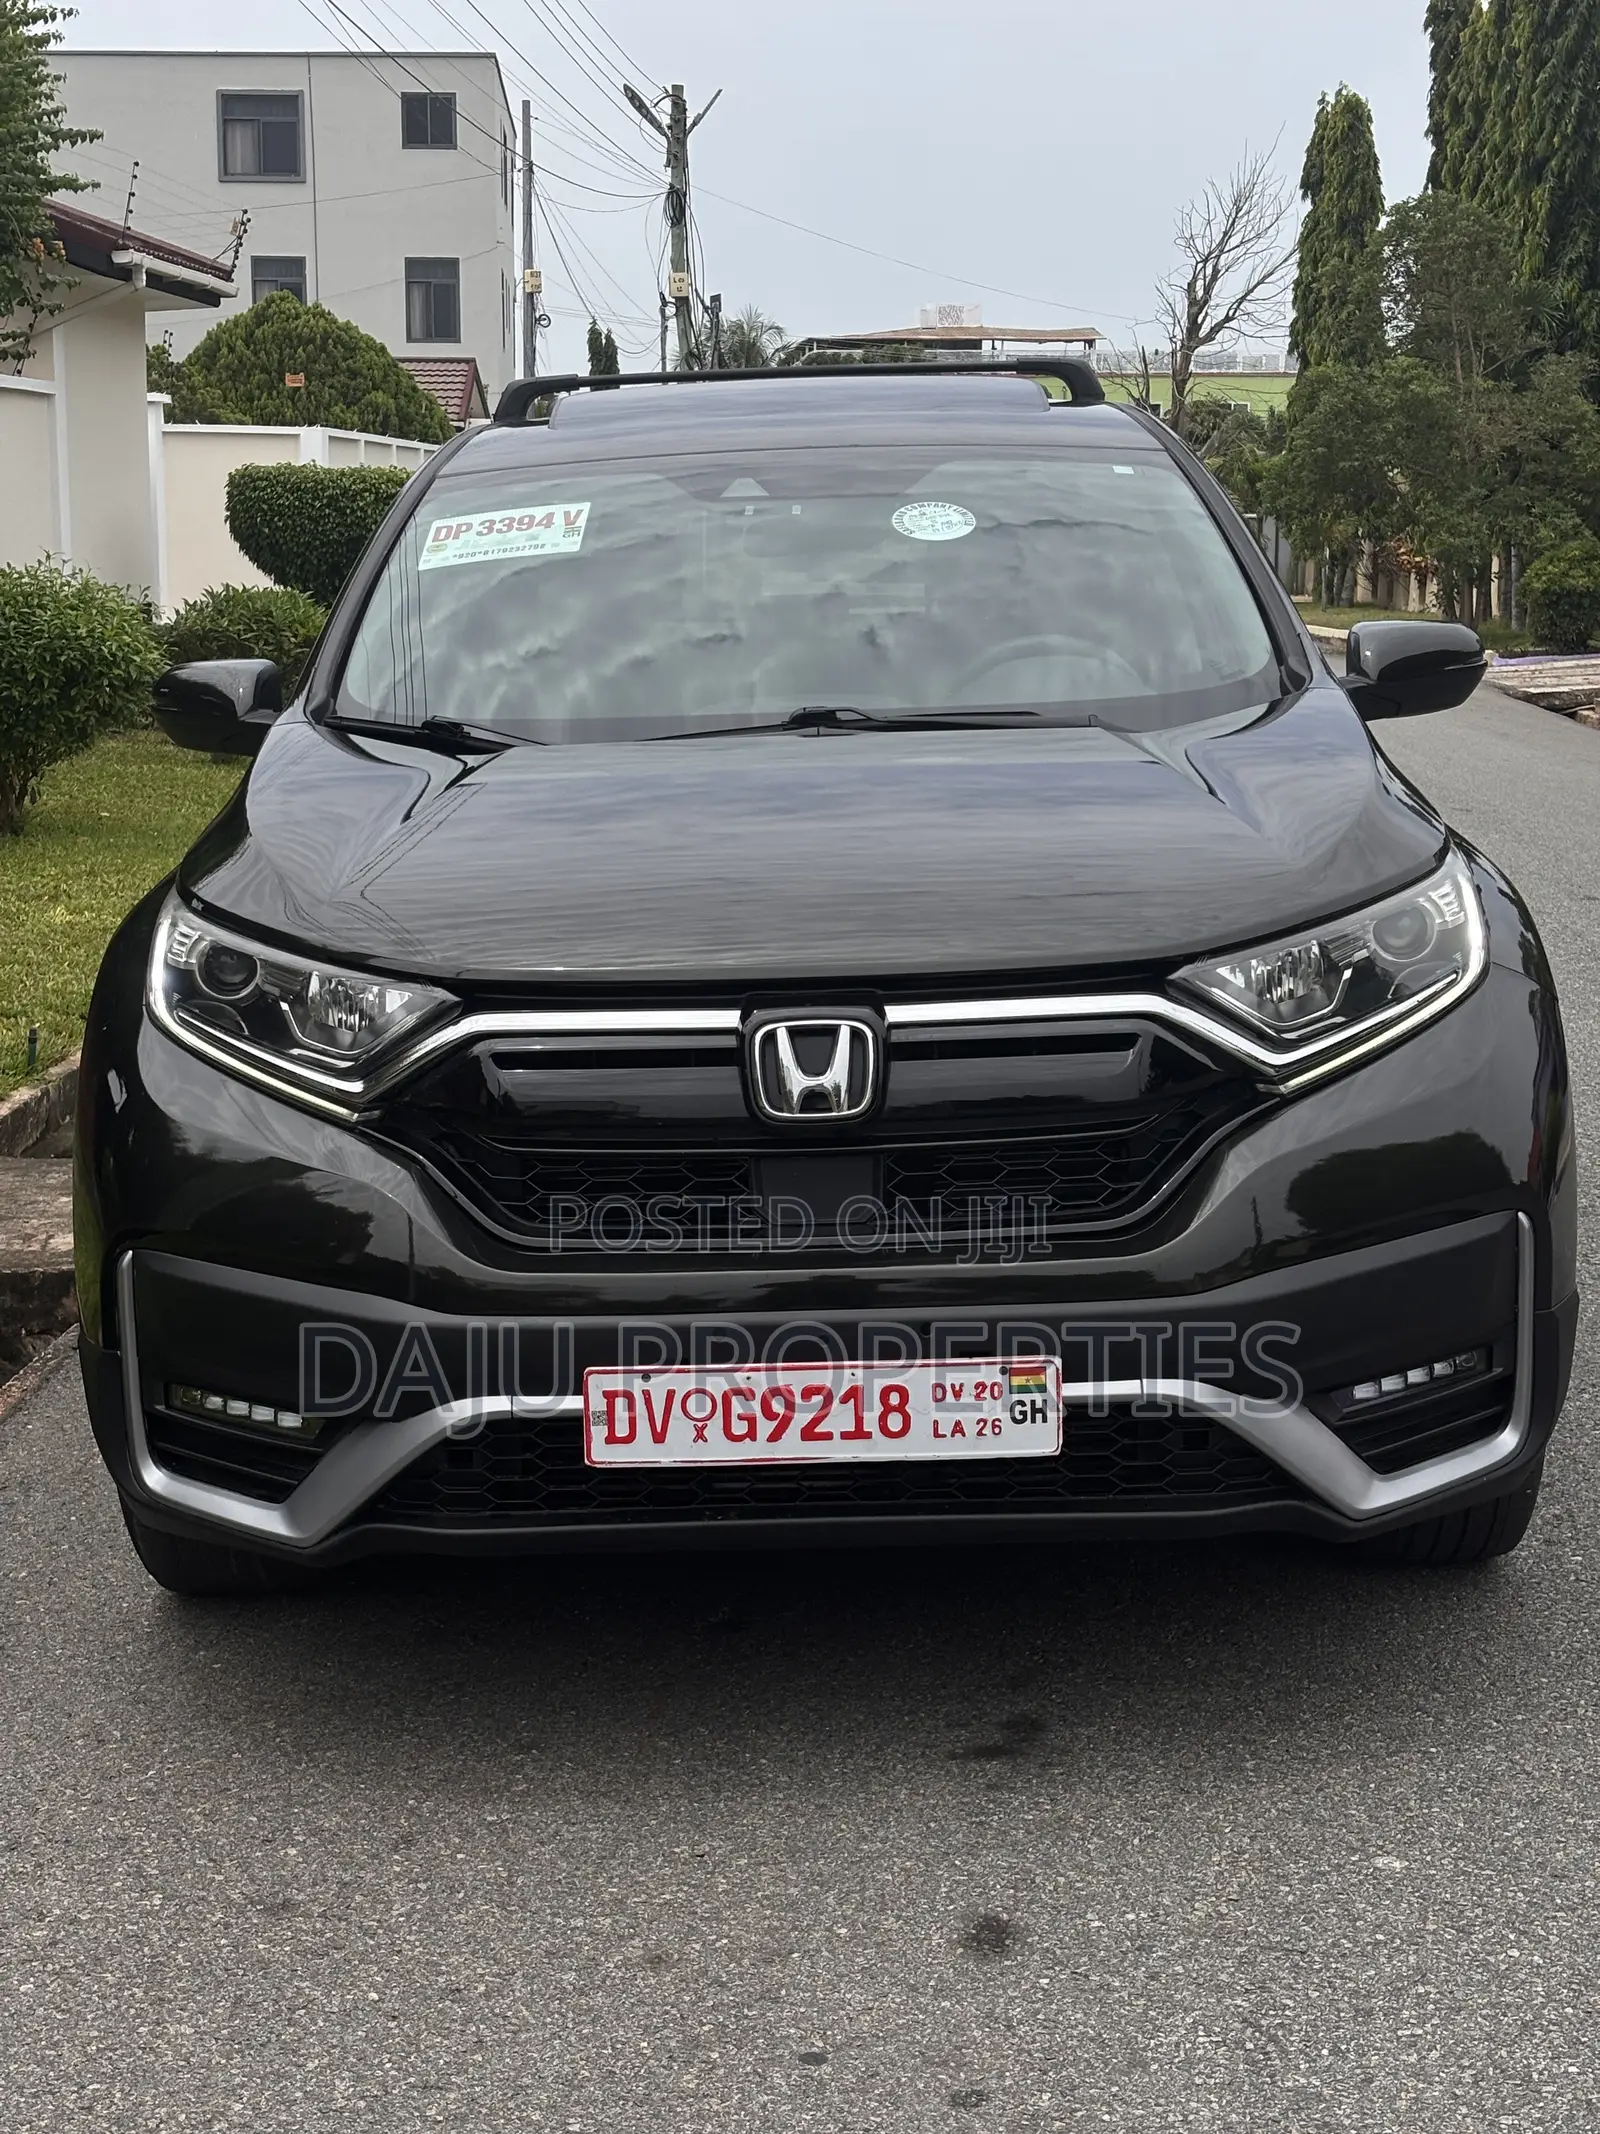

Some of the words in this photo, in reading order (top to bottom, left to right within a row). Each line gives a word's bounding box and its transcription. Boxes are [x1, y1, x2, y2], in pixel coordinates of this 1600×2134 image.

[904, 502, 954, 512] COMPANY
[431, 522, 474, 543] DP
[476, 511, 556, 537] 3394
[563, 509, 584, 526] V
[931, 1382, 965, 1403] DV
[973, 1381, 1004, 1402] 20
[602, 1388, 676, 1444] DV
[721, 1384, 911, 1443] G9218
[1009, 1399, 1048, 1425] GH
[932, 1418, 967, 1438] LA
[975, 1417, 1003, 1438] 26
